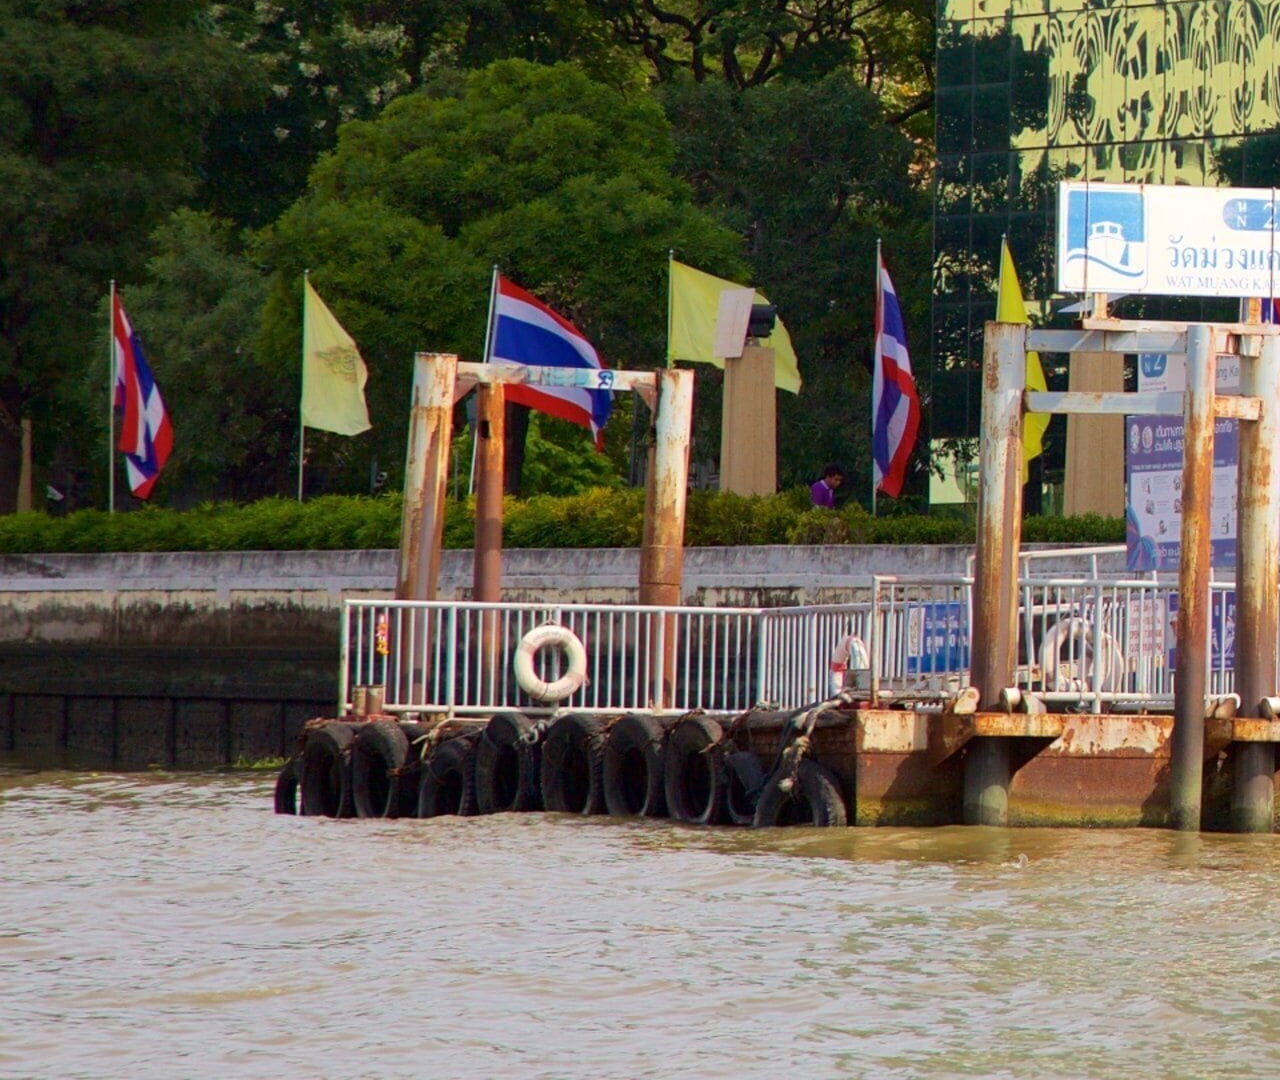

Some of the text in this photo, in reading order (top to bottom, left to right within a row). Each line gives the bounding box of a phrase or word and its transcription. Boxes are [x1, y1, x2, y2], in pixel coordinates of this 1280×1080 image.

[1236, 214, 1248, 228] N
[1263, 201, 1279, 229] 2
[1166, 275, 1193, 288] WAT
